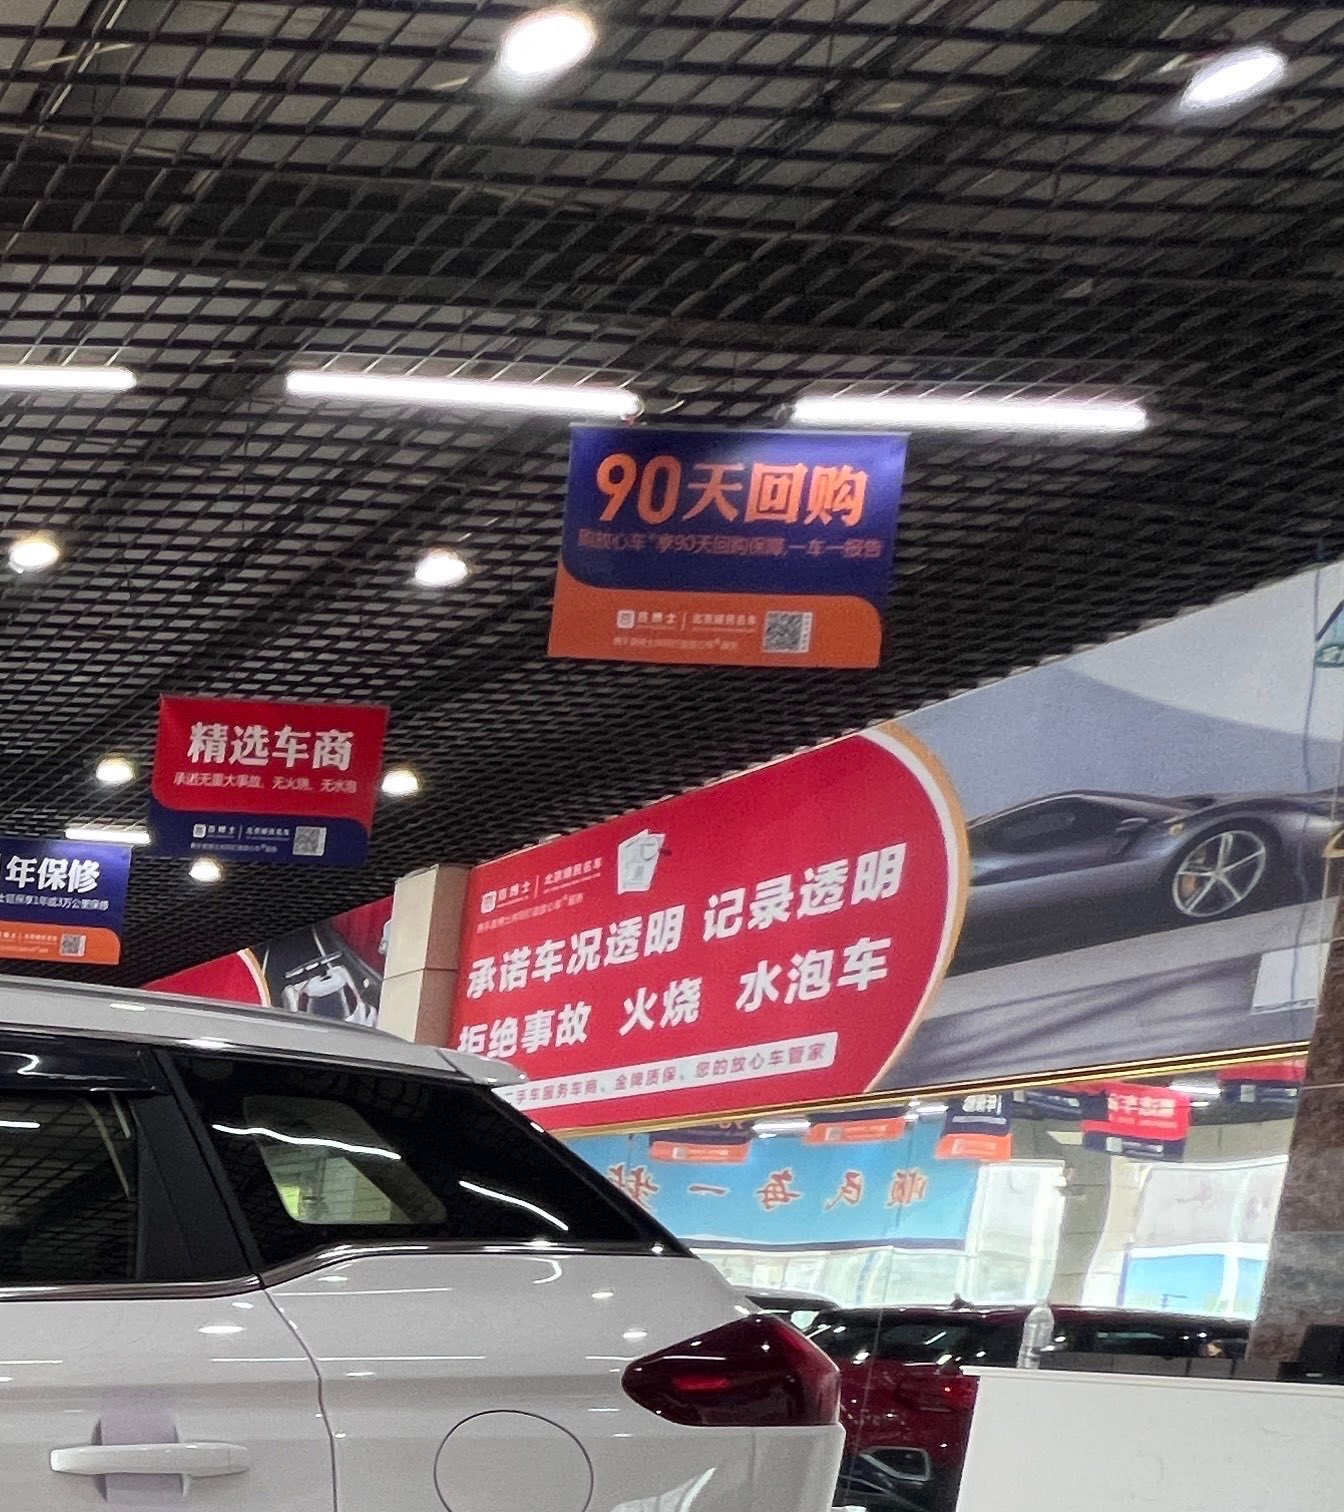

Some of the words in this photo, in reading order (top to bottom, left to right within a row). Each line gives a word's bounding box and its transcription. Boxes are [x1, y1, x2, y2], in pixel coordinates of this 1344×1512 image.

[596, 452, 869, 526] 90天回购
[187, 721, 354, 771] 精选车商
[466, 903, 687, 1000] 承诺车况透明
[702, 842, 908, 944] 记录透明
[456, 1000, 594, 1060] 拒绝事故
[618, 977, 703, 1037] 火烧
[735, 936, 892, 1014] 水泡车
